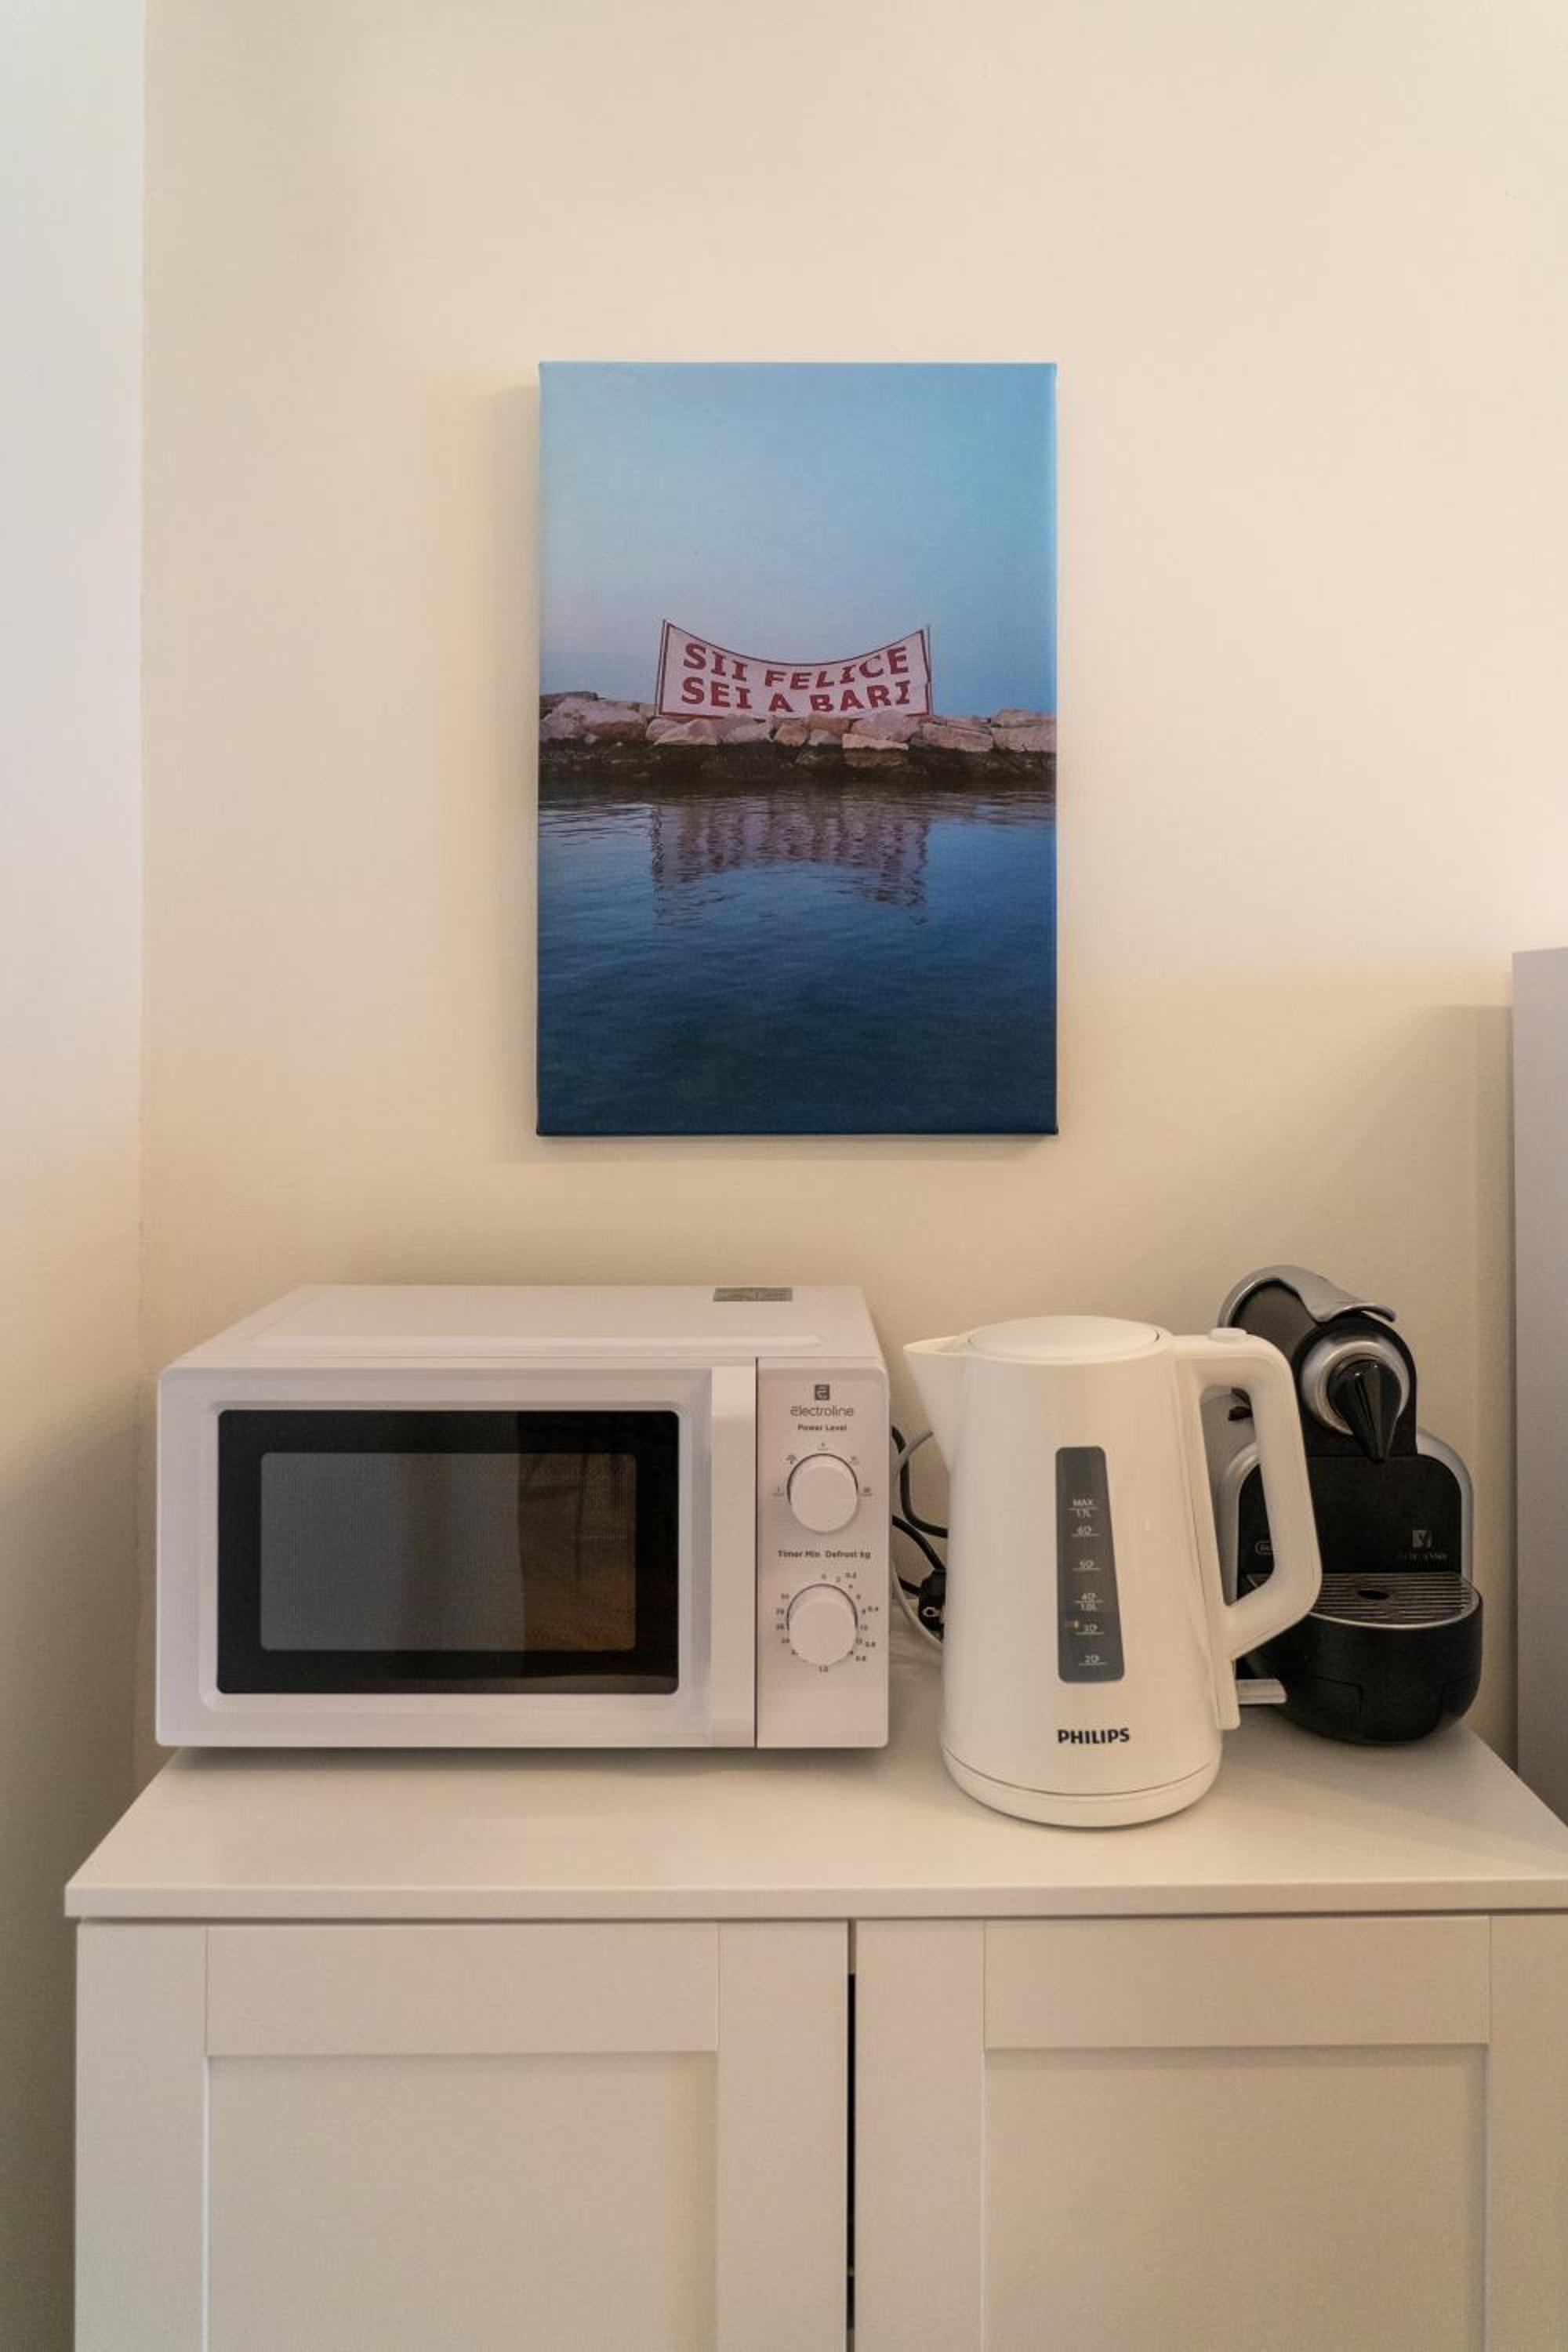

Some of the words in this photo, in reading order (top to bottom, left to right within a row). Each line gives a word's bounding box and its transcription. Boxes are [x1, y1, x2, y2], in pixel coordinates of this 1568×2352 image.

[683, 643, 748, 682] SII
[764, 646, 909, 691] FELICE
[681, 677, 752, 710] SEI
[768, 693, 794, 713] A
[810, 681, 910, 713] BARI
[1057, 1728, 1131, 1744] PHILIPS
